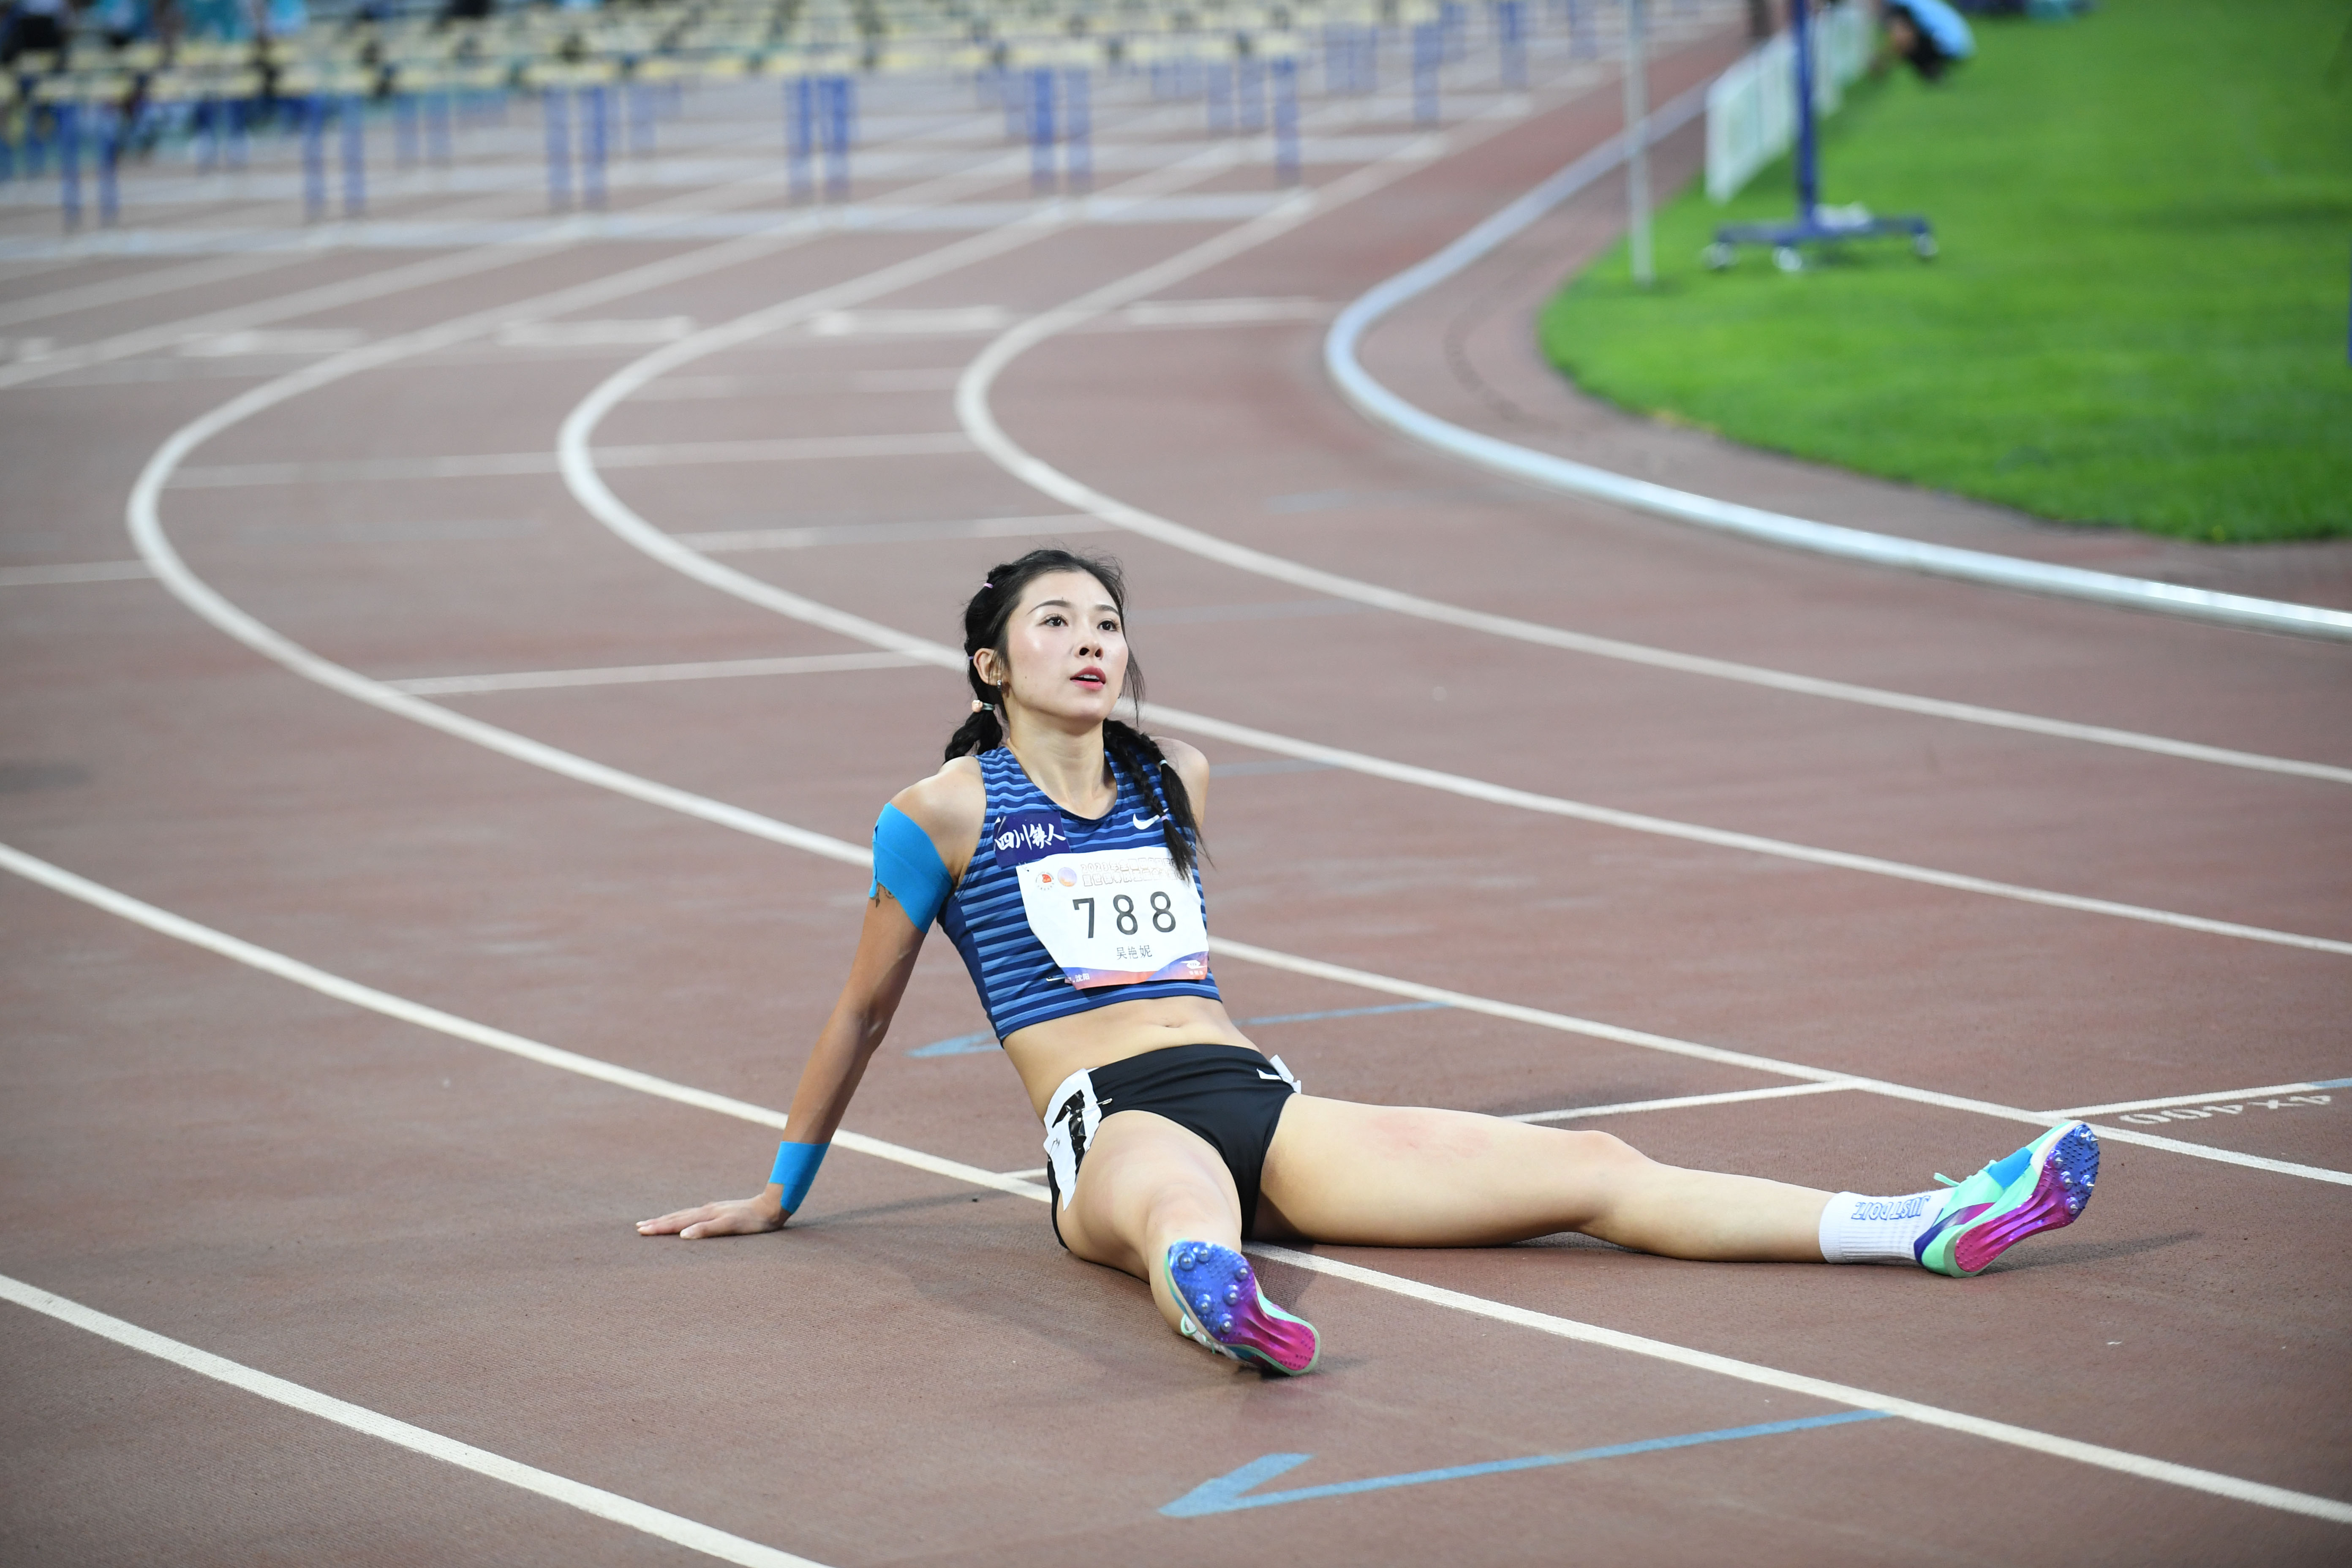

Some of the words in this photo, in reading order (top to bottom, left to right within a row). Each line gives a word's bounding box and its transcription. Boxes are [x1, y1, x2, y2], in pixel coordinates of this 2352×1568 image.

[994, 823, 1067, 850] 四川铁人
[1072, 891, 1176, 939] 788
[1116, 945, 1152, 960] 吴艳妮
